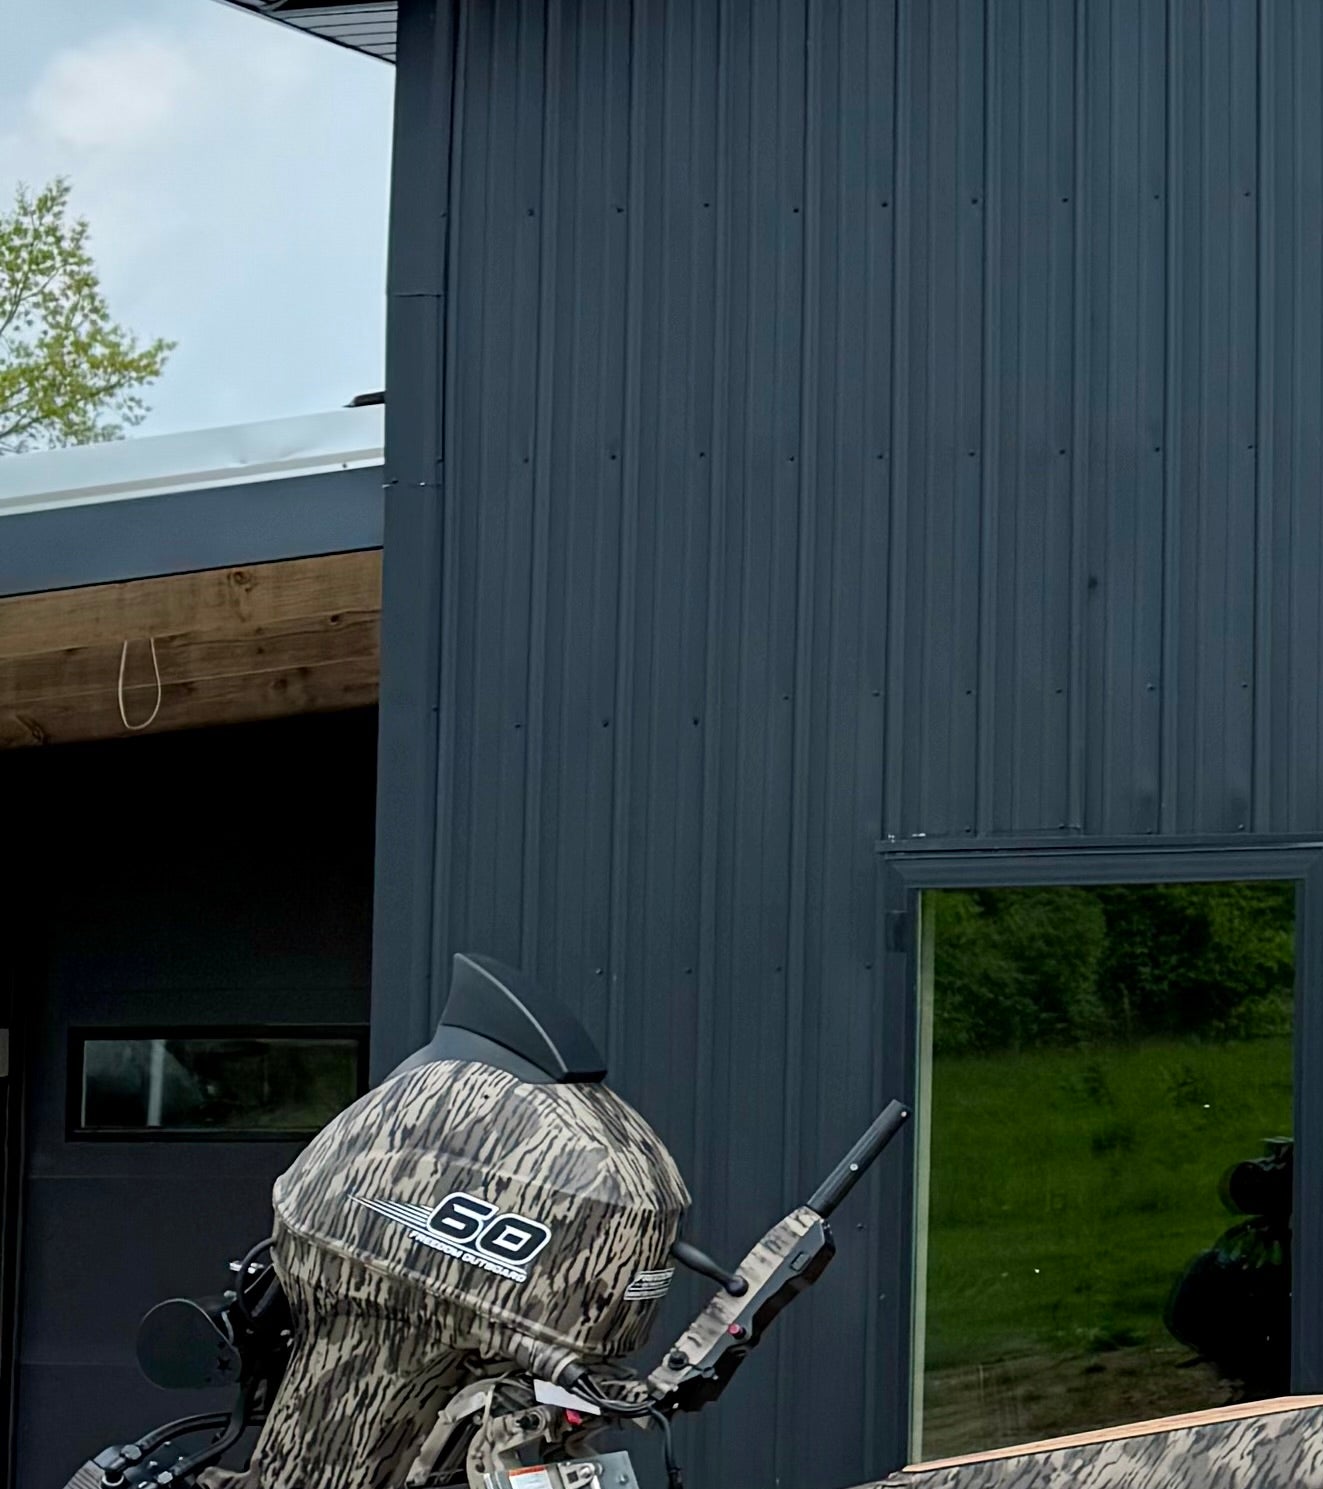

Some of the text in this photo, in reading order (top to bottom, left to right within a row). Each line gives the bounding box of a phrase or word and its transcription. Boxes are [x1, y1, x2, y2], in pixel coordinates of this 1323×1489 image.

[408, 1230, 527, 1283] FREEDOM OUTBOARD
[426, 1191, 552, 1265] 60
